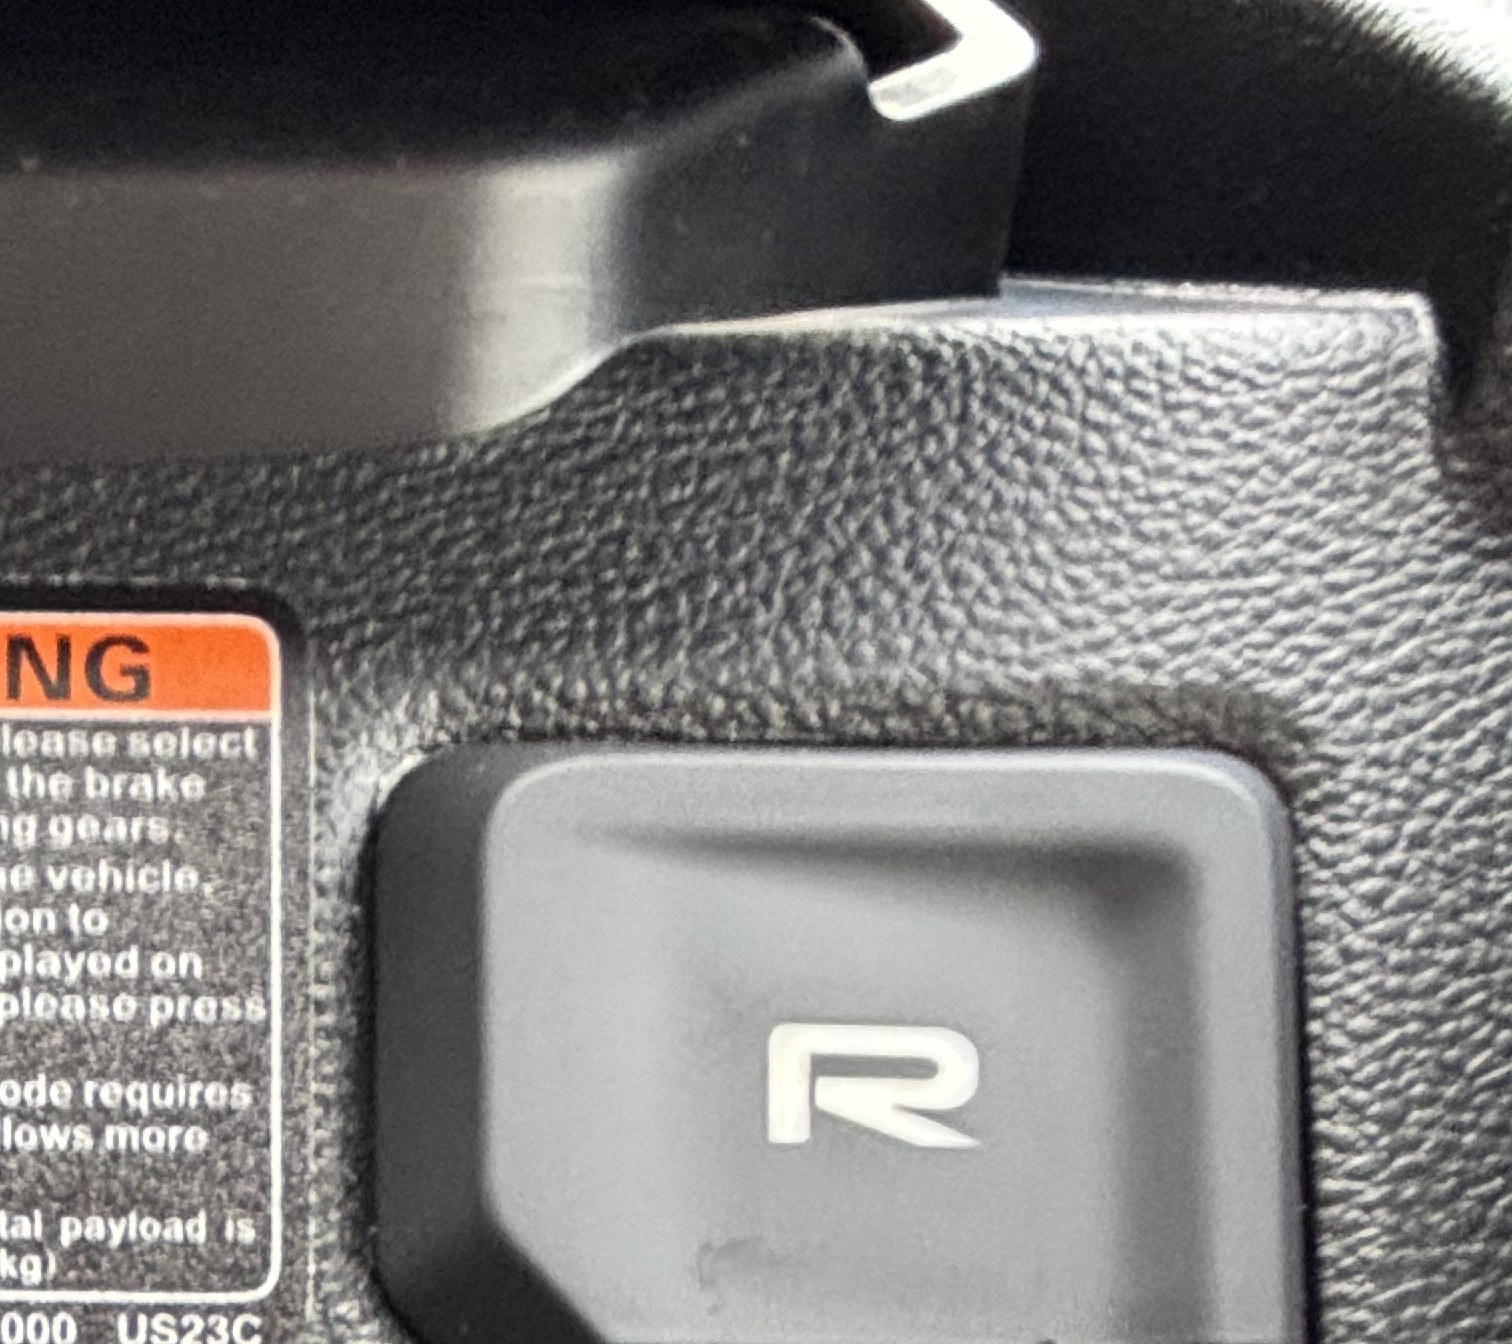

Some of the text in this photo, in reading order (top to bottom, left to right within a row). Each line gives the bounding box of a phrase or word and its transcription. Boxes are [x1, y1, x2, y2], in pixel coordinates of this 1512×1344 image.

[128, 726, 257, 761] select
[7, 763, 73, 801] the
[87, 765, 206, 802] brake
[69, 903, 109, 937] to
[151, 949, 203, 980] on
[151, 993, 266, 1029] press
[84, 1074, 254, 1115] requires
[769, 1024, 979, 1147] R
[105, 1123, 209, 1153] more
[60, 1209, 207, 1248] payload
[224, 1214, 255, 1244] is
